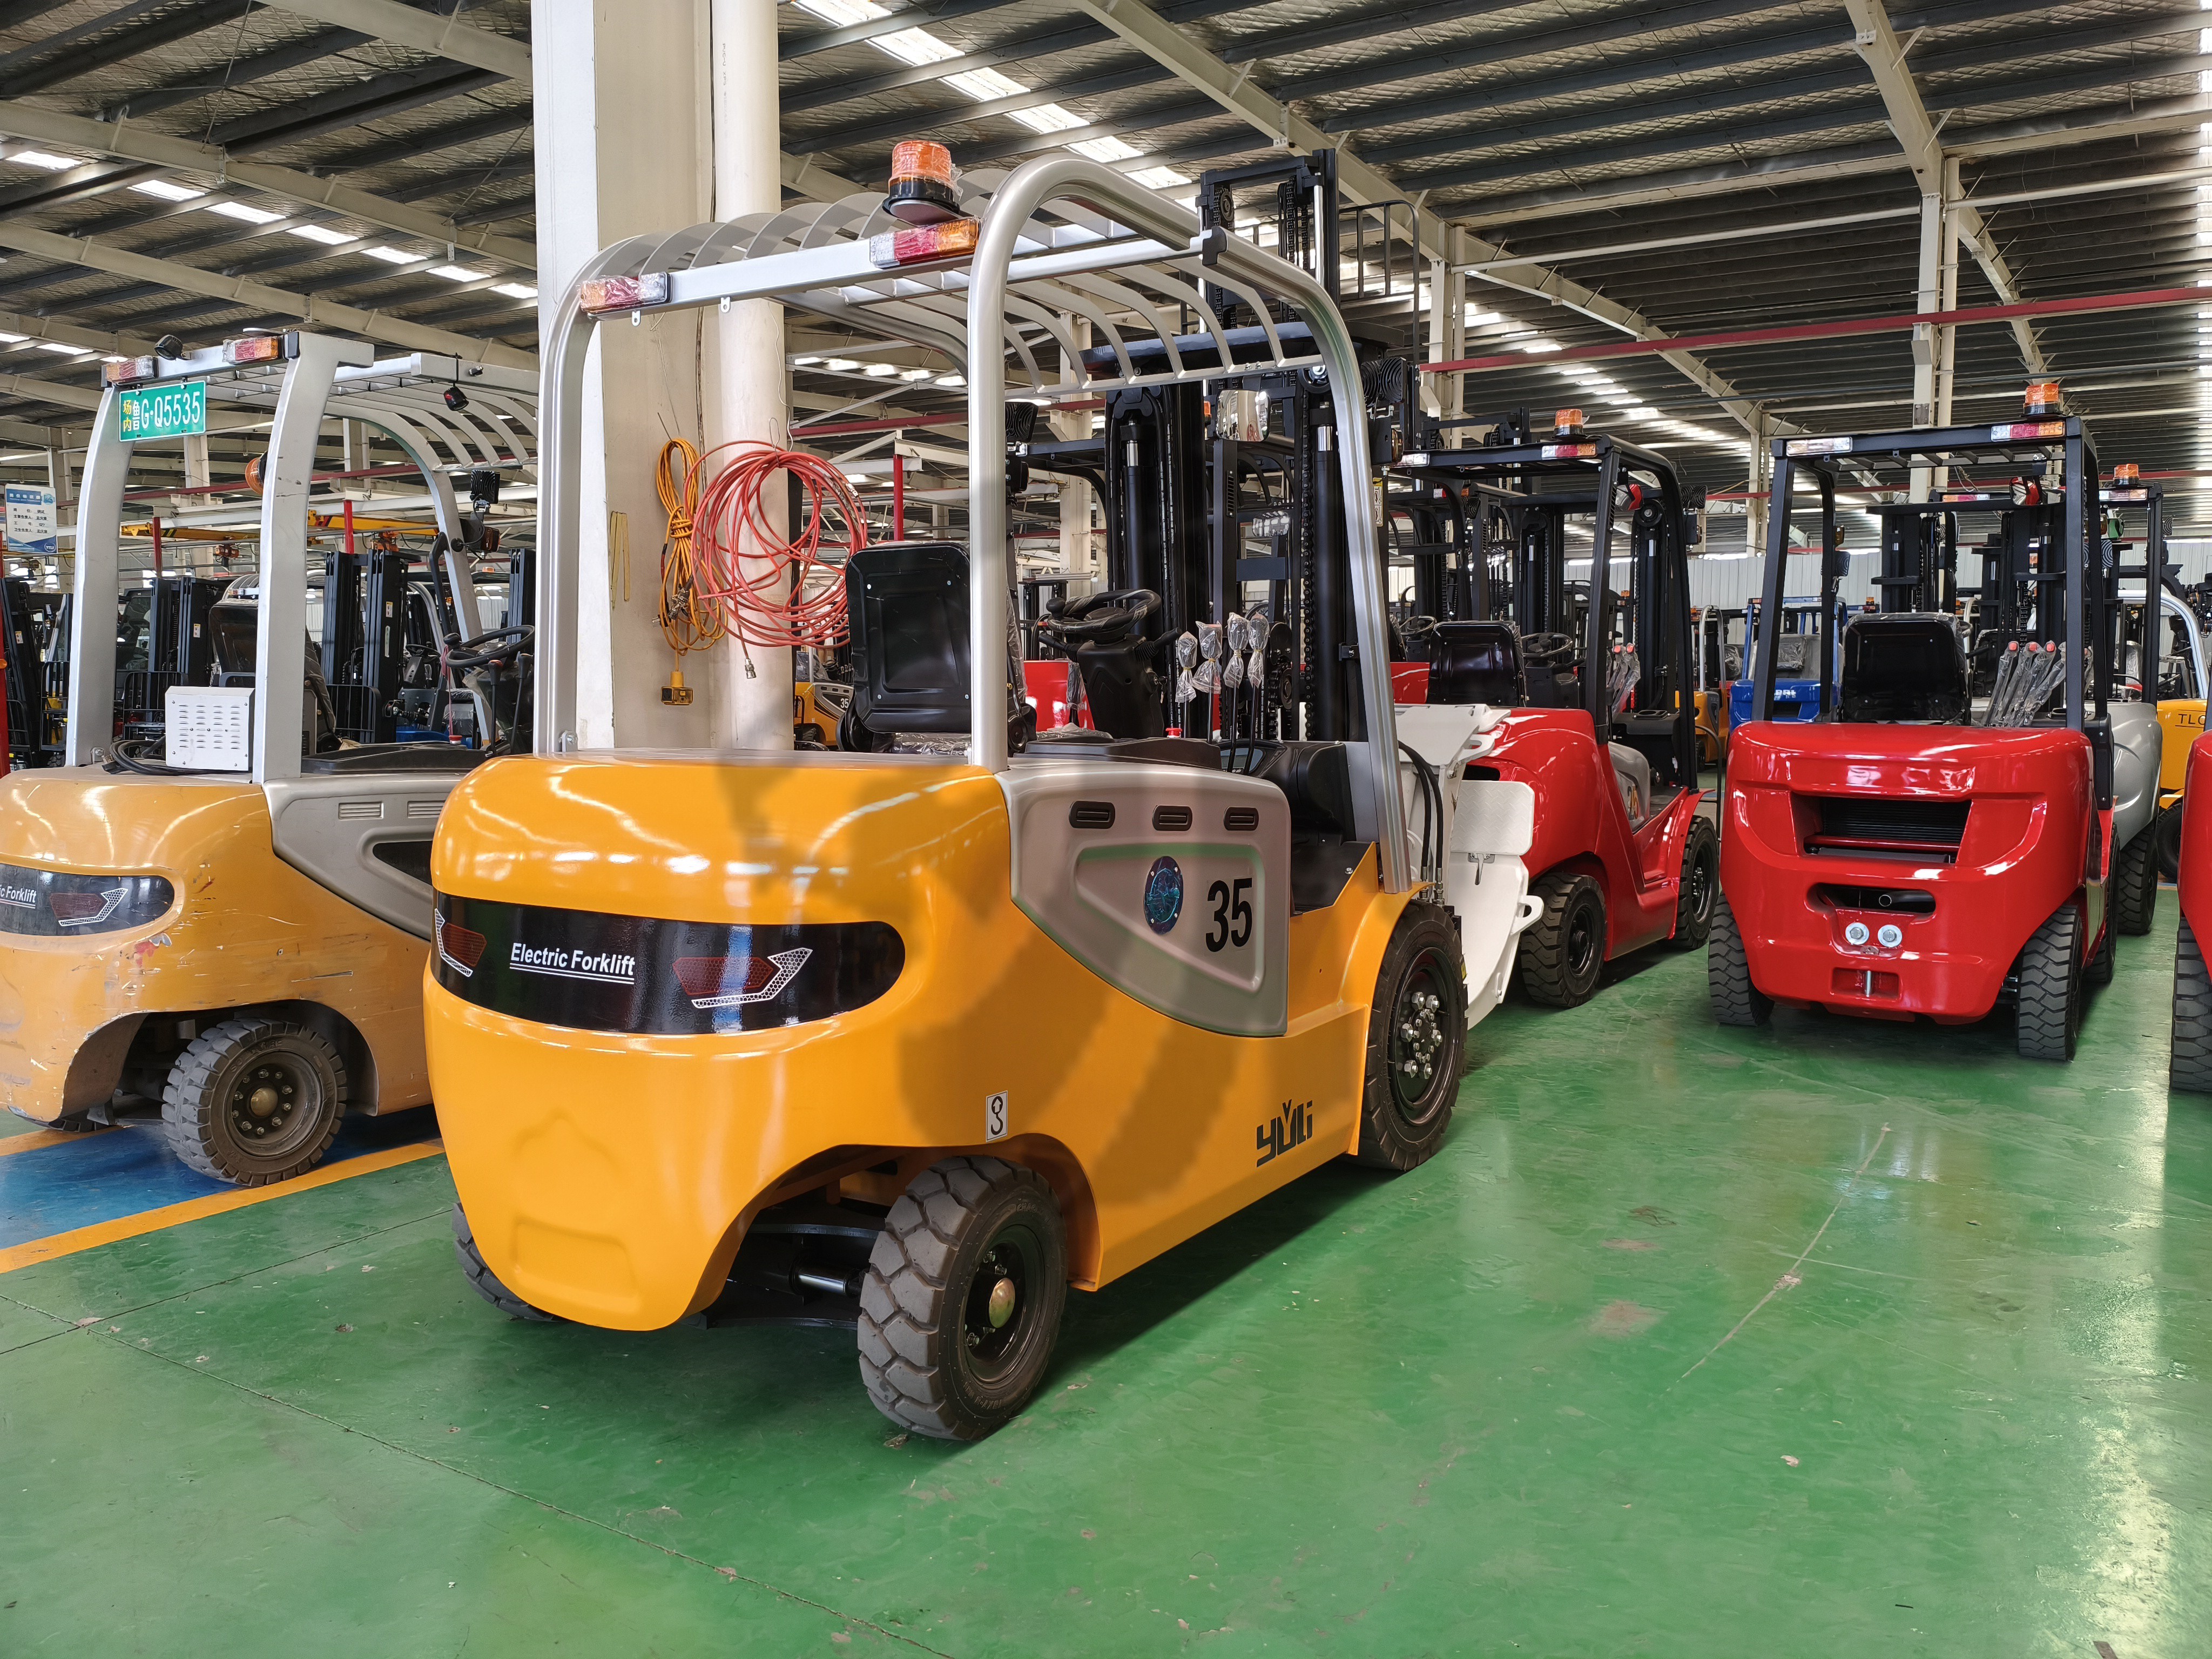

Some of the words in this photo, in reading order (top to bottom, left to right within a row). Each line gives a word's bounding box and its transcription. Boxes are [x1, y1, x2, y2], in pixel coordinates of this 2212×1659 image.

[123, 400, 131, 432] 场内
[840, 698, 849, 709] 35
[6, 886, 37, 903] Forklift
[1205, 877, 1252, 952] 35
[510, 942, 568, 968] Electric
[571, 949, 636, 976] Forklift
